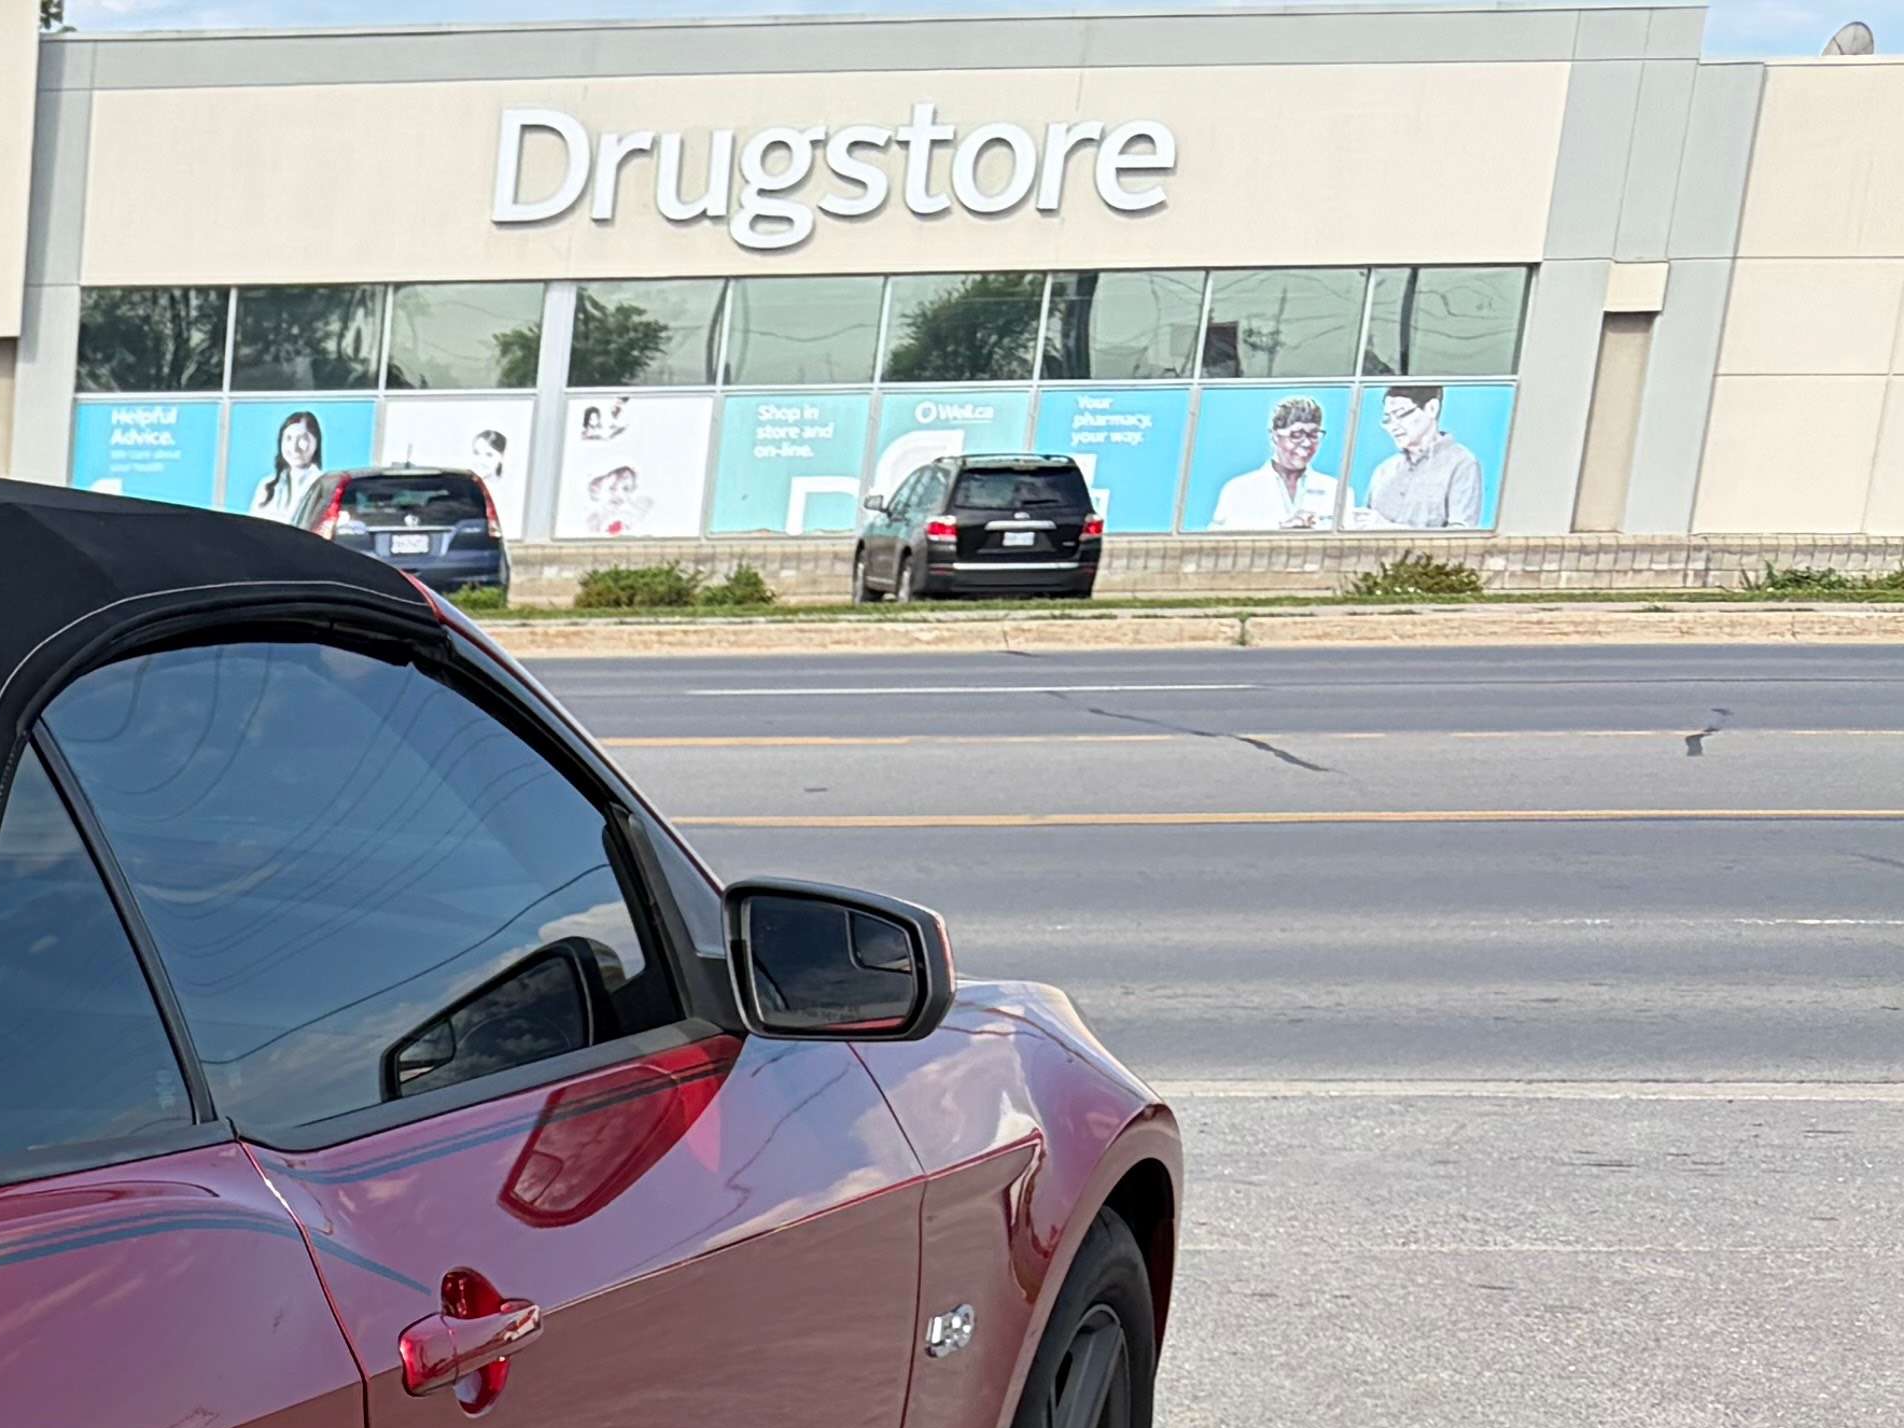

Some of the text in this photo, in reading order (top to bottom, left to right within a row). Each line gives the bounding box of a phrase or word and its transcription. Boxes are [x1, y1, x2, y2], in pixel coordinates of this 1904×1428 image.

[492, 103, 1176, 250] Drugstore
[1075, 396, 1114, 410] Your
[111, 406, 177, 427] Helpful
[757, 404, 819, 424] Shop in
[110, 428, 176, 446] Advice.
[756, 422, 835, 439] store and
[1071, 431, 1106, 446] your
